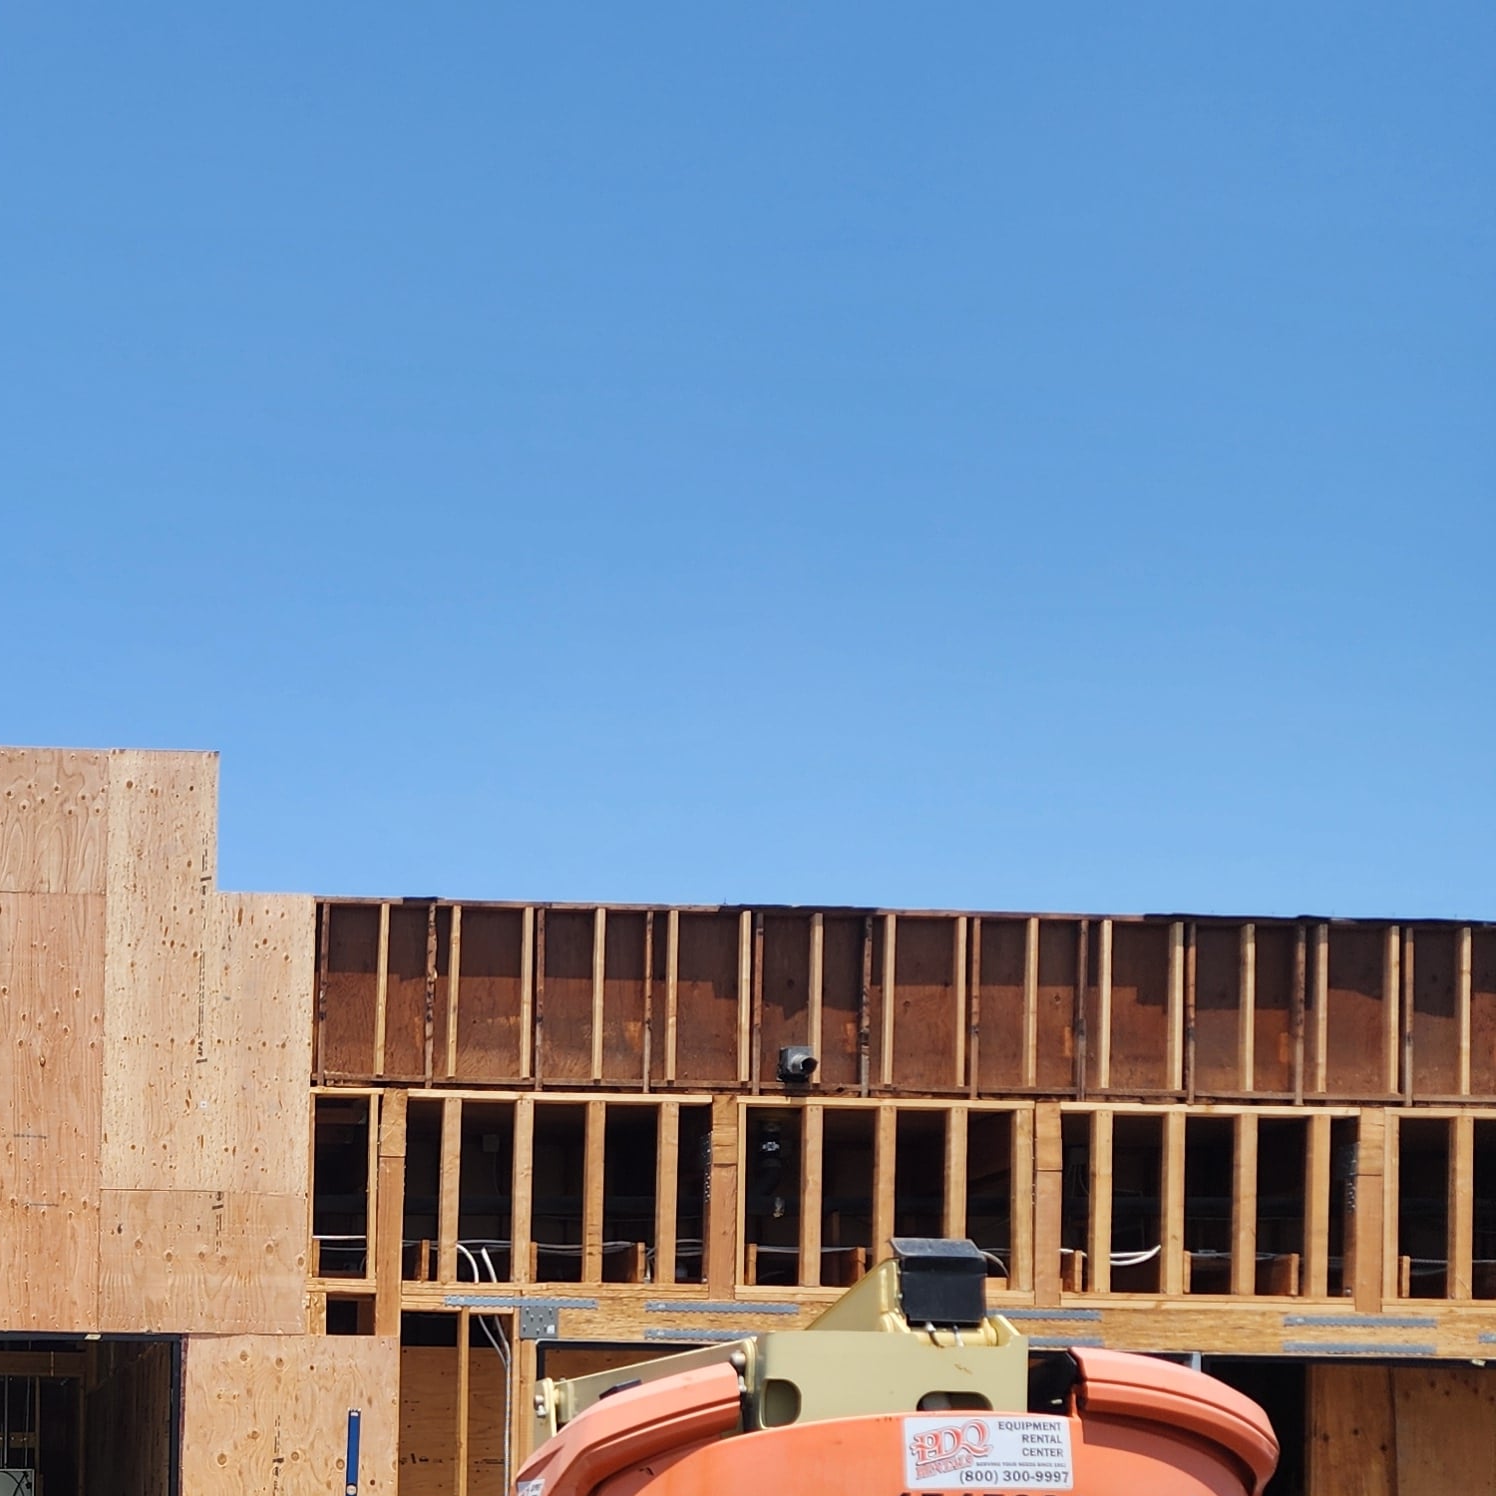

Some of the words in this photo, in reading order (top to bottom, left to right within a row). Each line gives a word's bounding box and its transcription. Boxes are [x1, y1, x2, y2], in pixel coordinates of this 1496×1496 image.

[998, 1421, 1061, 1431] EQUIPMENT
[910, 1418, 992, 1466] PDQ
[1022, 1434, 1062, 1444] RENTAL
[1022, 1447, 1064, 1458] CENTER
[959, 1470, 999, 1485] (800)
[1003, 1470, 1070, 1484] 300-9997
